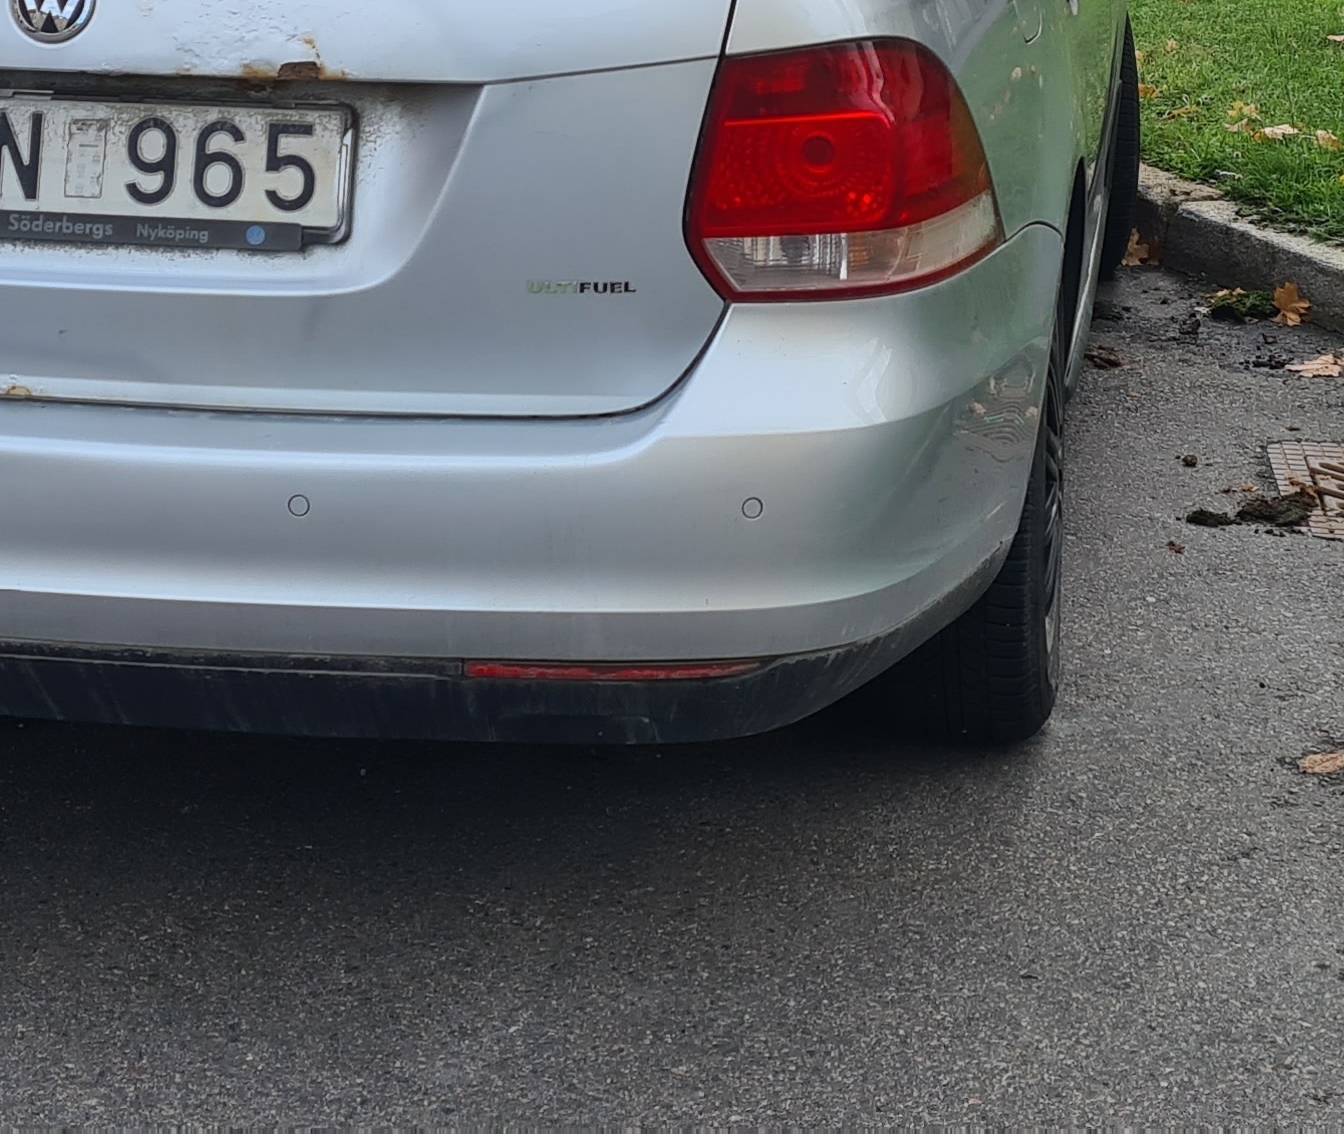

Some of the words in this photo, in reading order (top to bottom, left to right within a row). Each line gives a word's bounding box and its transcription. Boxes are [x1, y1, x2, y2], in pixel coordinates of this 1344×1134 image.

[125, 116, 316, 212] 965
[7, 213, 114, 240] Söderbergs
[136, 224, 209, 243] Nyköping
